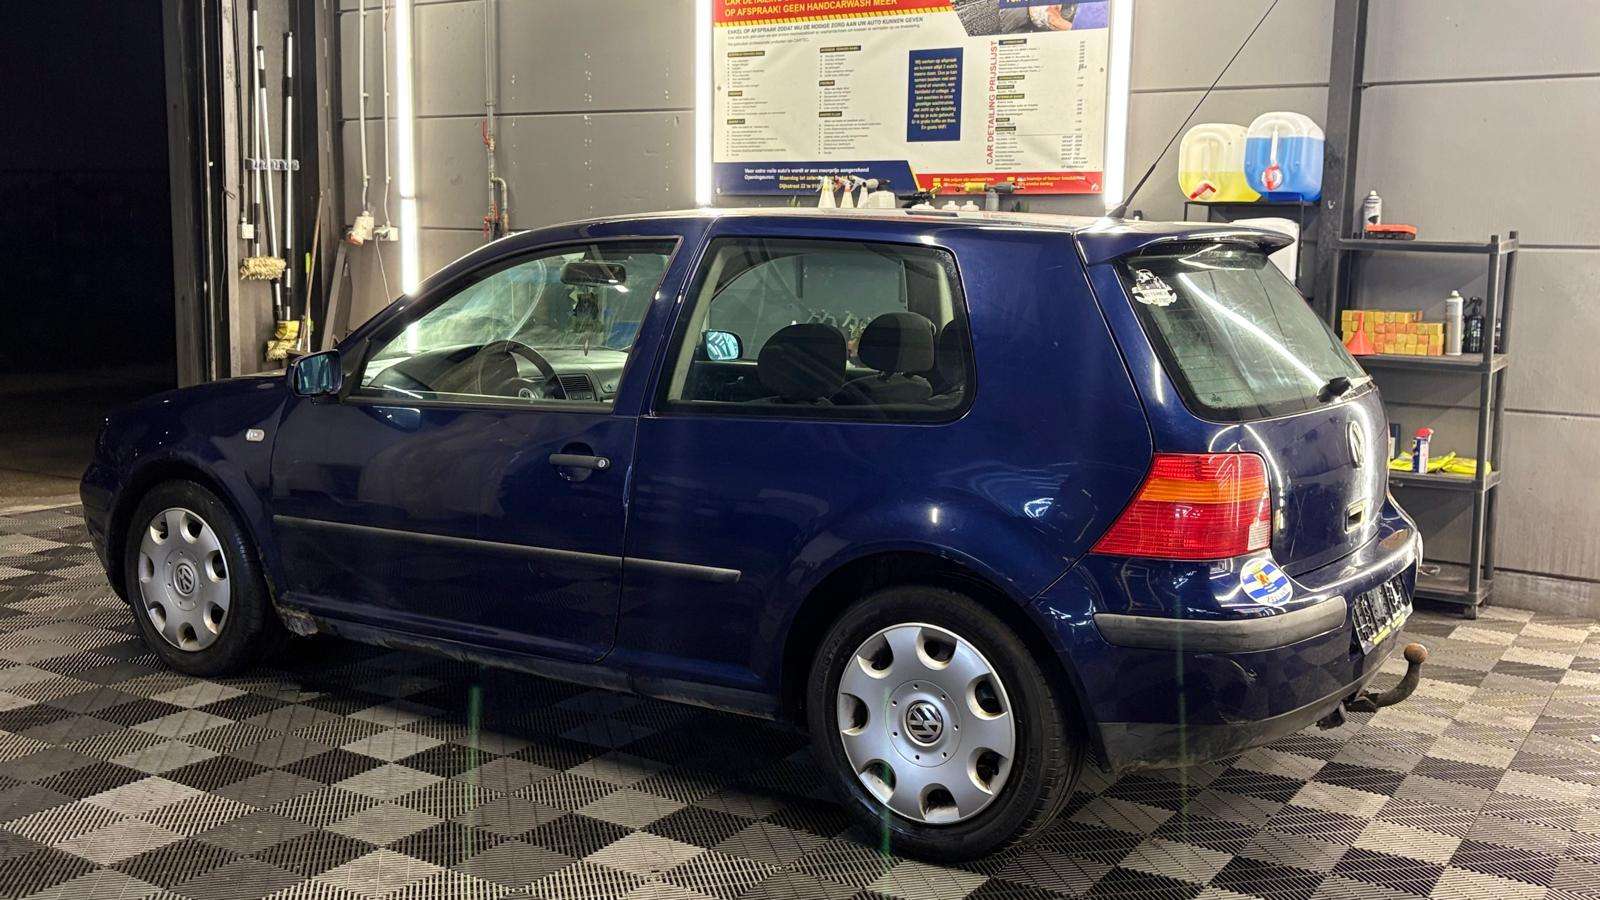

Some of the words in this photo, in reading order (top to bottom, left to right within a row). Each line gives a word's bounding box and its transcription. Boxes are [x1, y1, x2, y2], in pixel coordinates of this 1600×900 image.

[725, 9, 736, 17] OP
[737, 5, 781, 16] AFSPRAAK!
[783, 3, 805, 13] GEEN
[806, 0, 871, 11] HANDCARWASH
[989, 41, 998, 92] PRIJSLIJST
[987, 94, 996, 142] DETAILING
[986, 144, 994, 165] CAR
